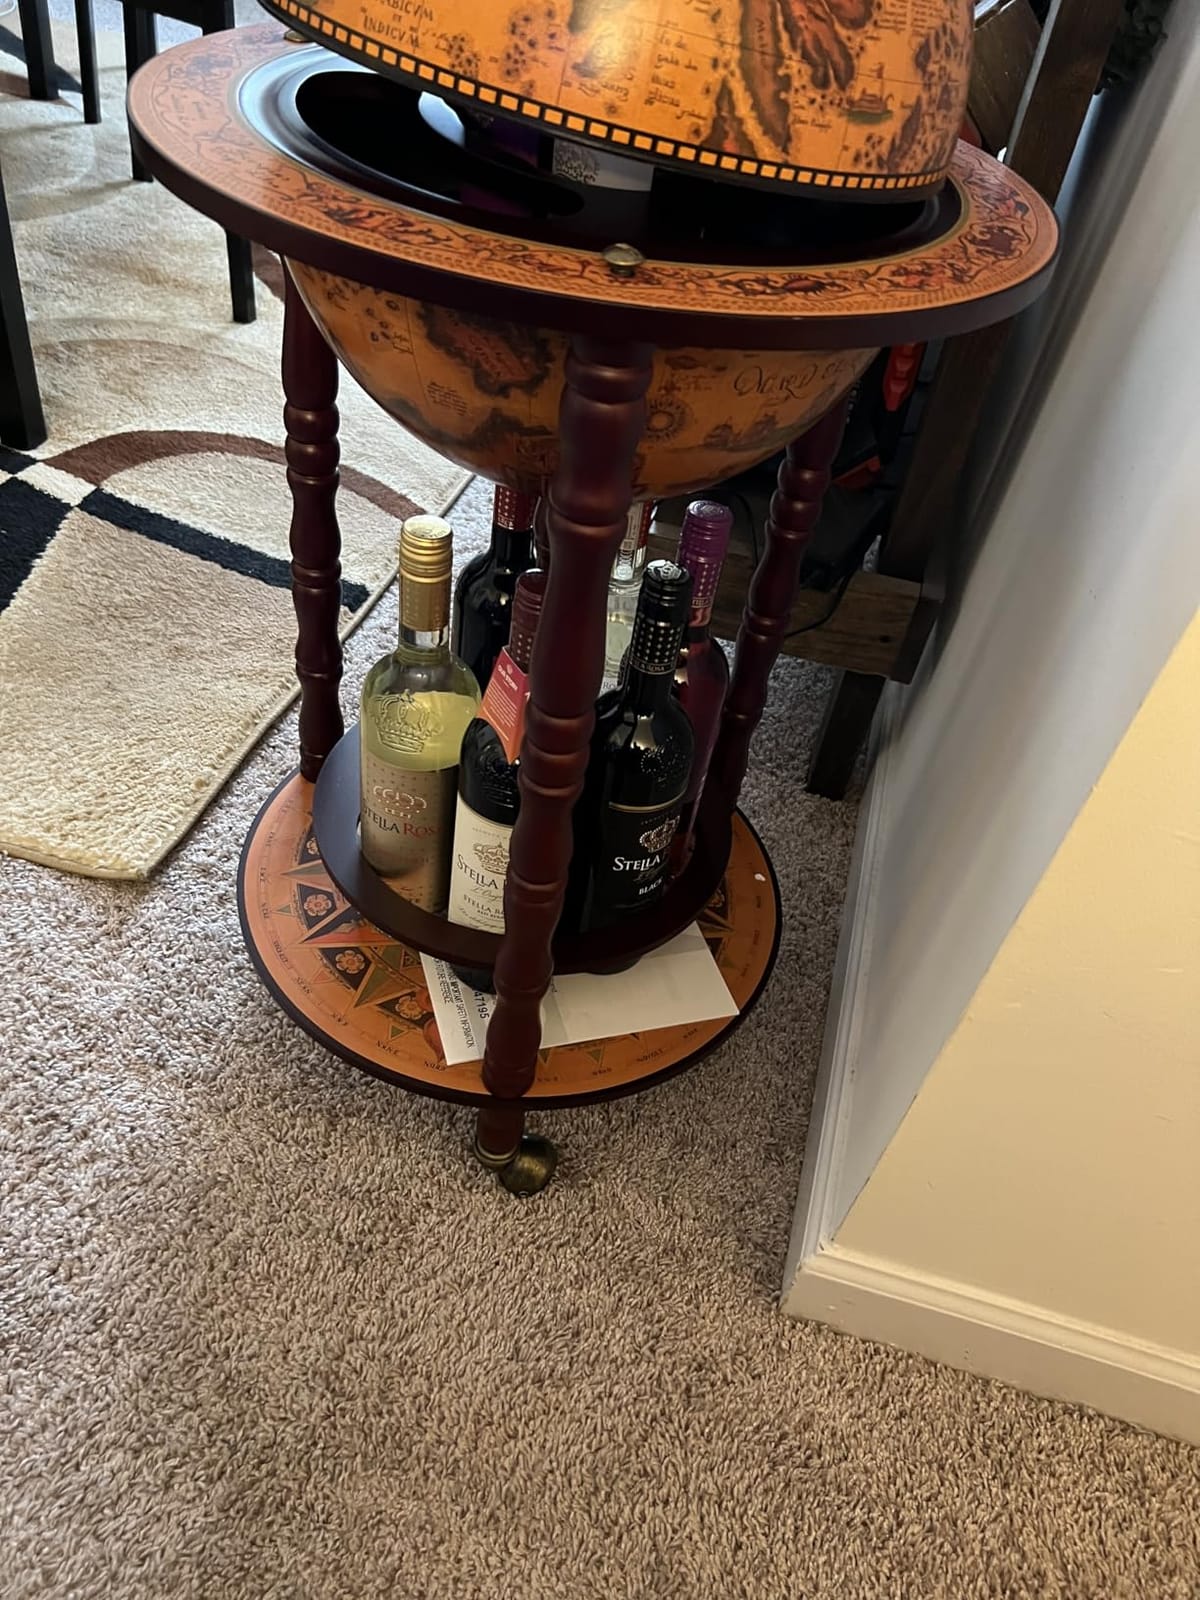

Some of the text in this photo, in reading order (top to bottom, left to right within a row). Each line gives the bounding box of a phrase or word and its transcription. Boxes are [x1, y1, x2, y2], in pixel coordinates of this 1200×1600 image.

[456, 853, 498, 890] STELLA
[612, 854, 660, 872] STELLA
[639, 876, 663, 895] BLACK
[456, 1002, 466, 1018] SAFETY
